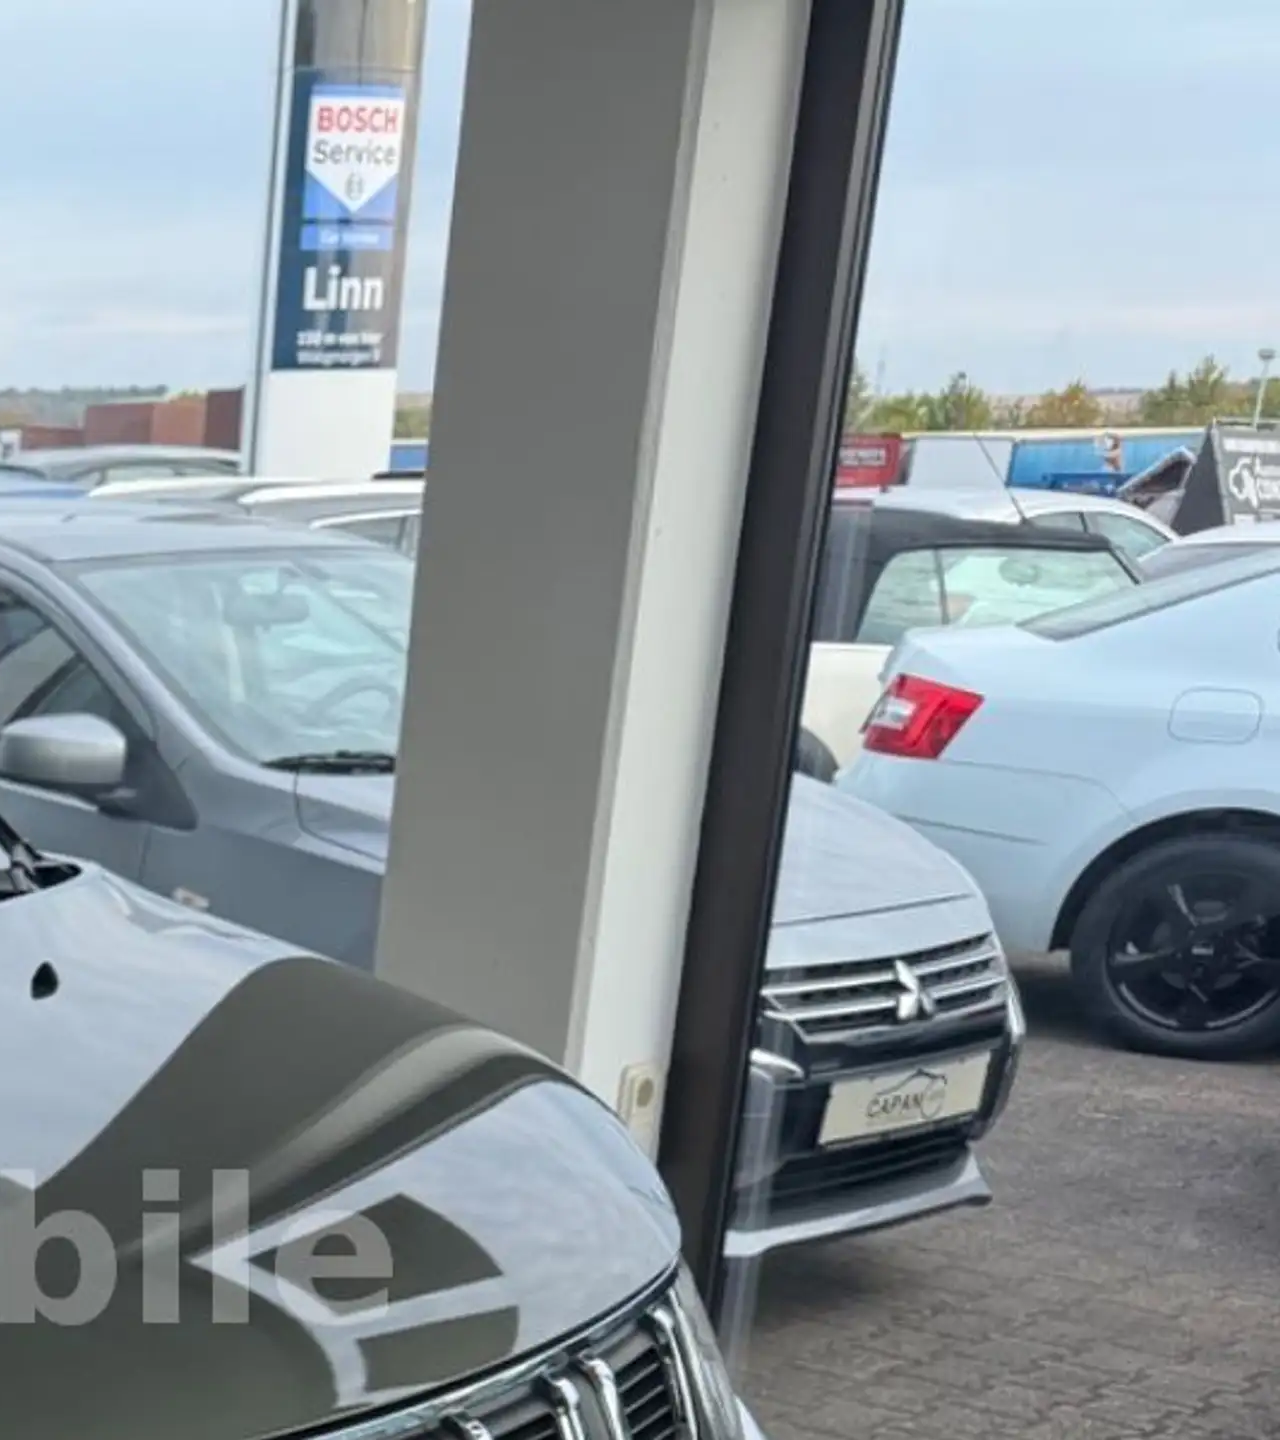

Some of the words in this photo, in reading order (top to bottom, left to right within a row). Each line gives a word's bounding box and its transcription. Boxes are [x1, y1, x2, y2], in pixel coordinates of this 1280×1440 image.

[316, 104, 399, 134] BOSCH
[312, 139, 397, 166] Service
[303, 264, 384, 312] Linn
